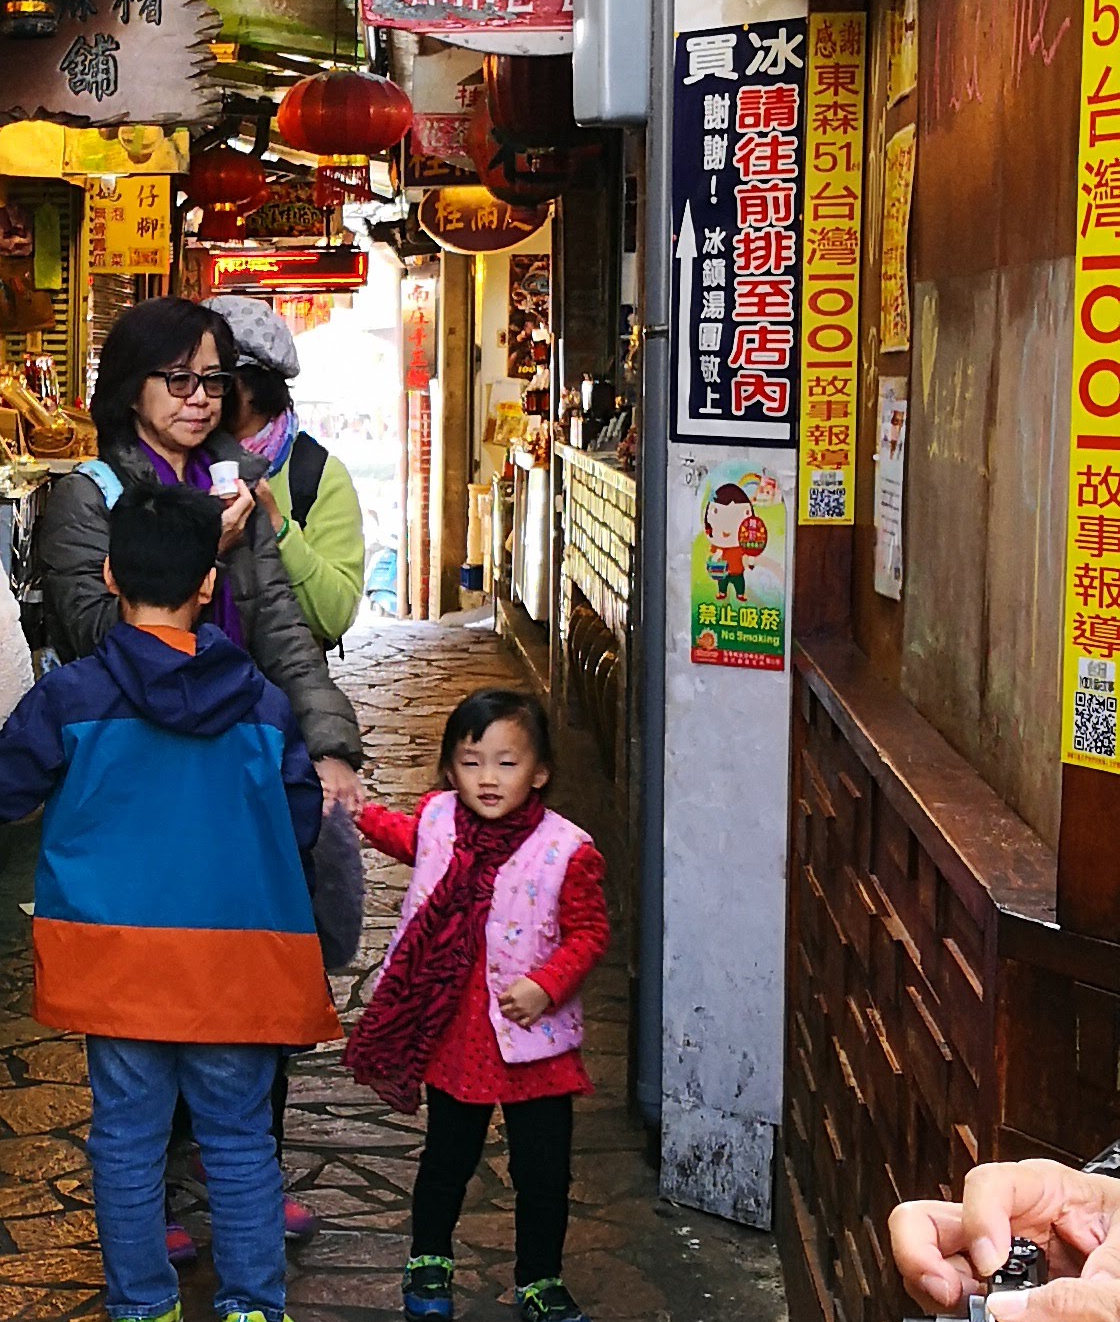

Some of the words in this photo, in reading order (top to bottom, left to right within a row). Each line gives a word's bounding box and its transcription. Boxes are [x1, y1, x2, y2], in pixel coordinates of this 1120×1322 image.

[814, 19, 862, 59] 感謝
[730, 82, 801, 419] 請往前排至店內
[699, 603, 780, 630] 禁止吸菸
[721, 630, 735, 641] No
[737, 631, 780, 647] Smoking
